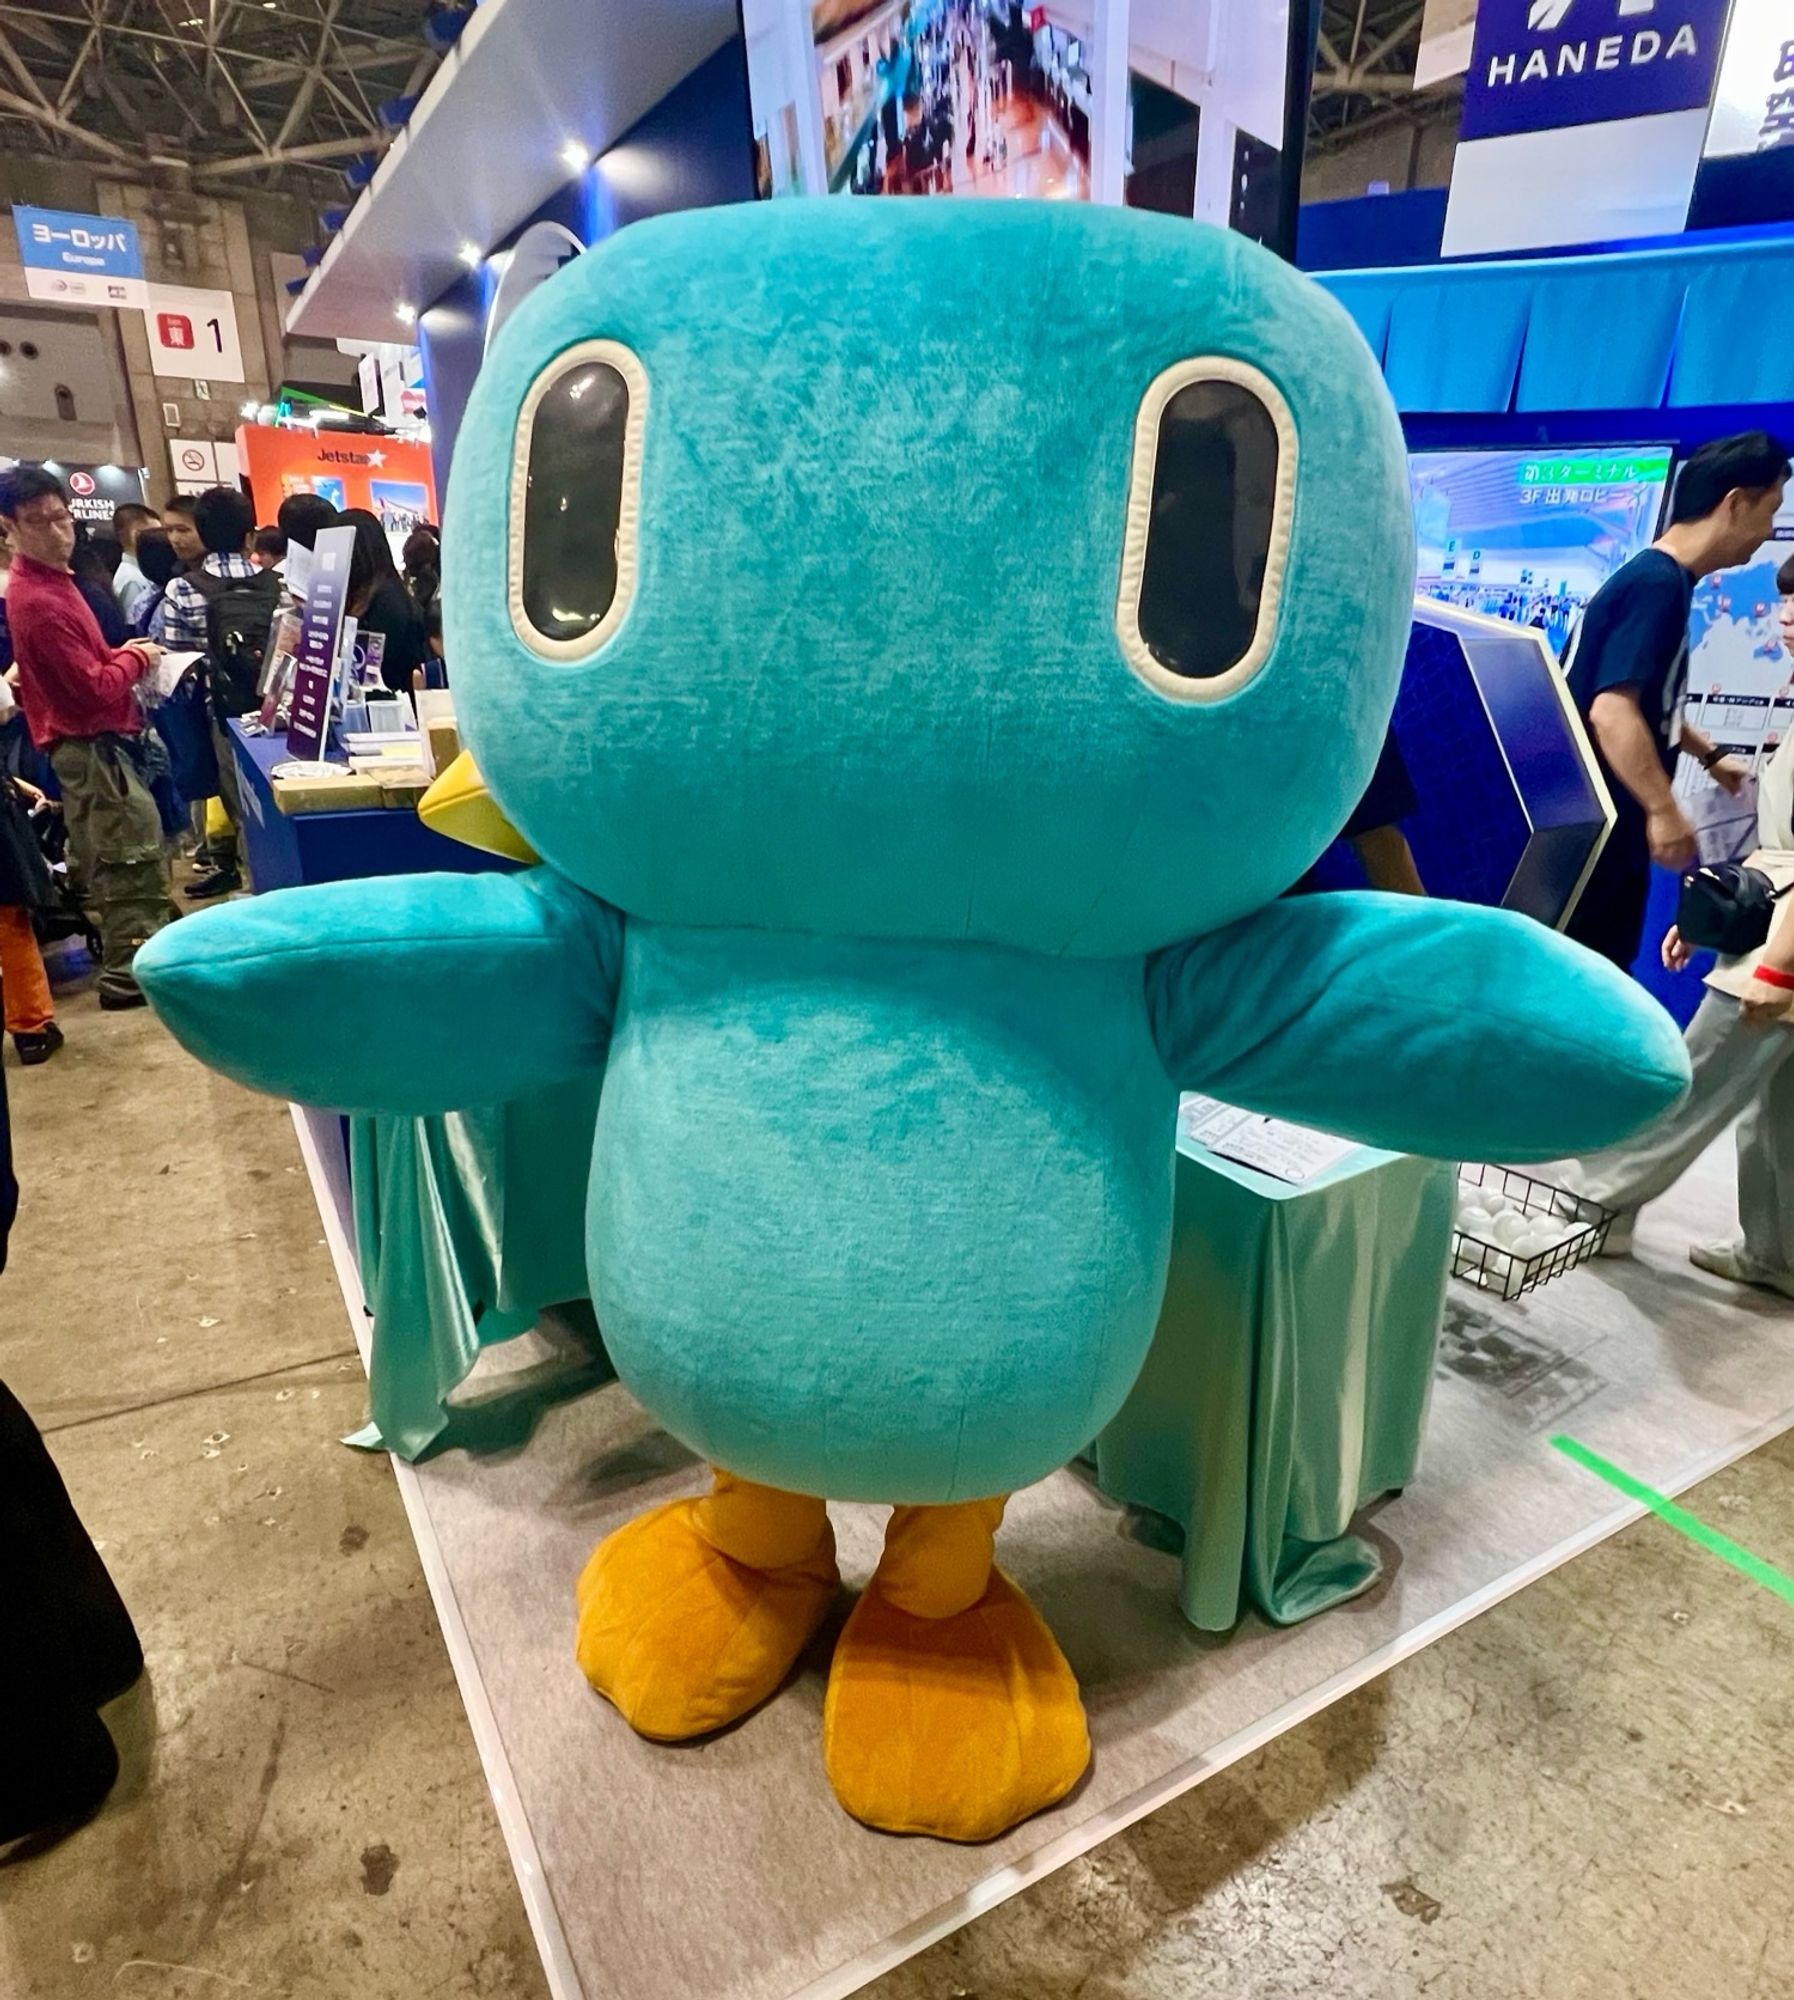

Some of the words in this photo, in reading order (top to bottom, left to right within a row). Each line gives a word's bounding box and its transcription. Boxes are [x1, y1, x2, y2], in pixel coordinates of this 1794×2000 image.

[1487, 23, 1697, 88] HANEDA
[32, 223, 126, 252] ヨーロッパ
[169, 326, 185, 346] 東
[206, 318, 223, 353] 1
[1520, 489, 1541, 504] 3F
